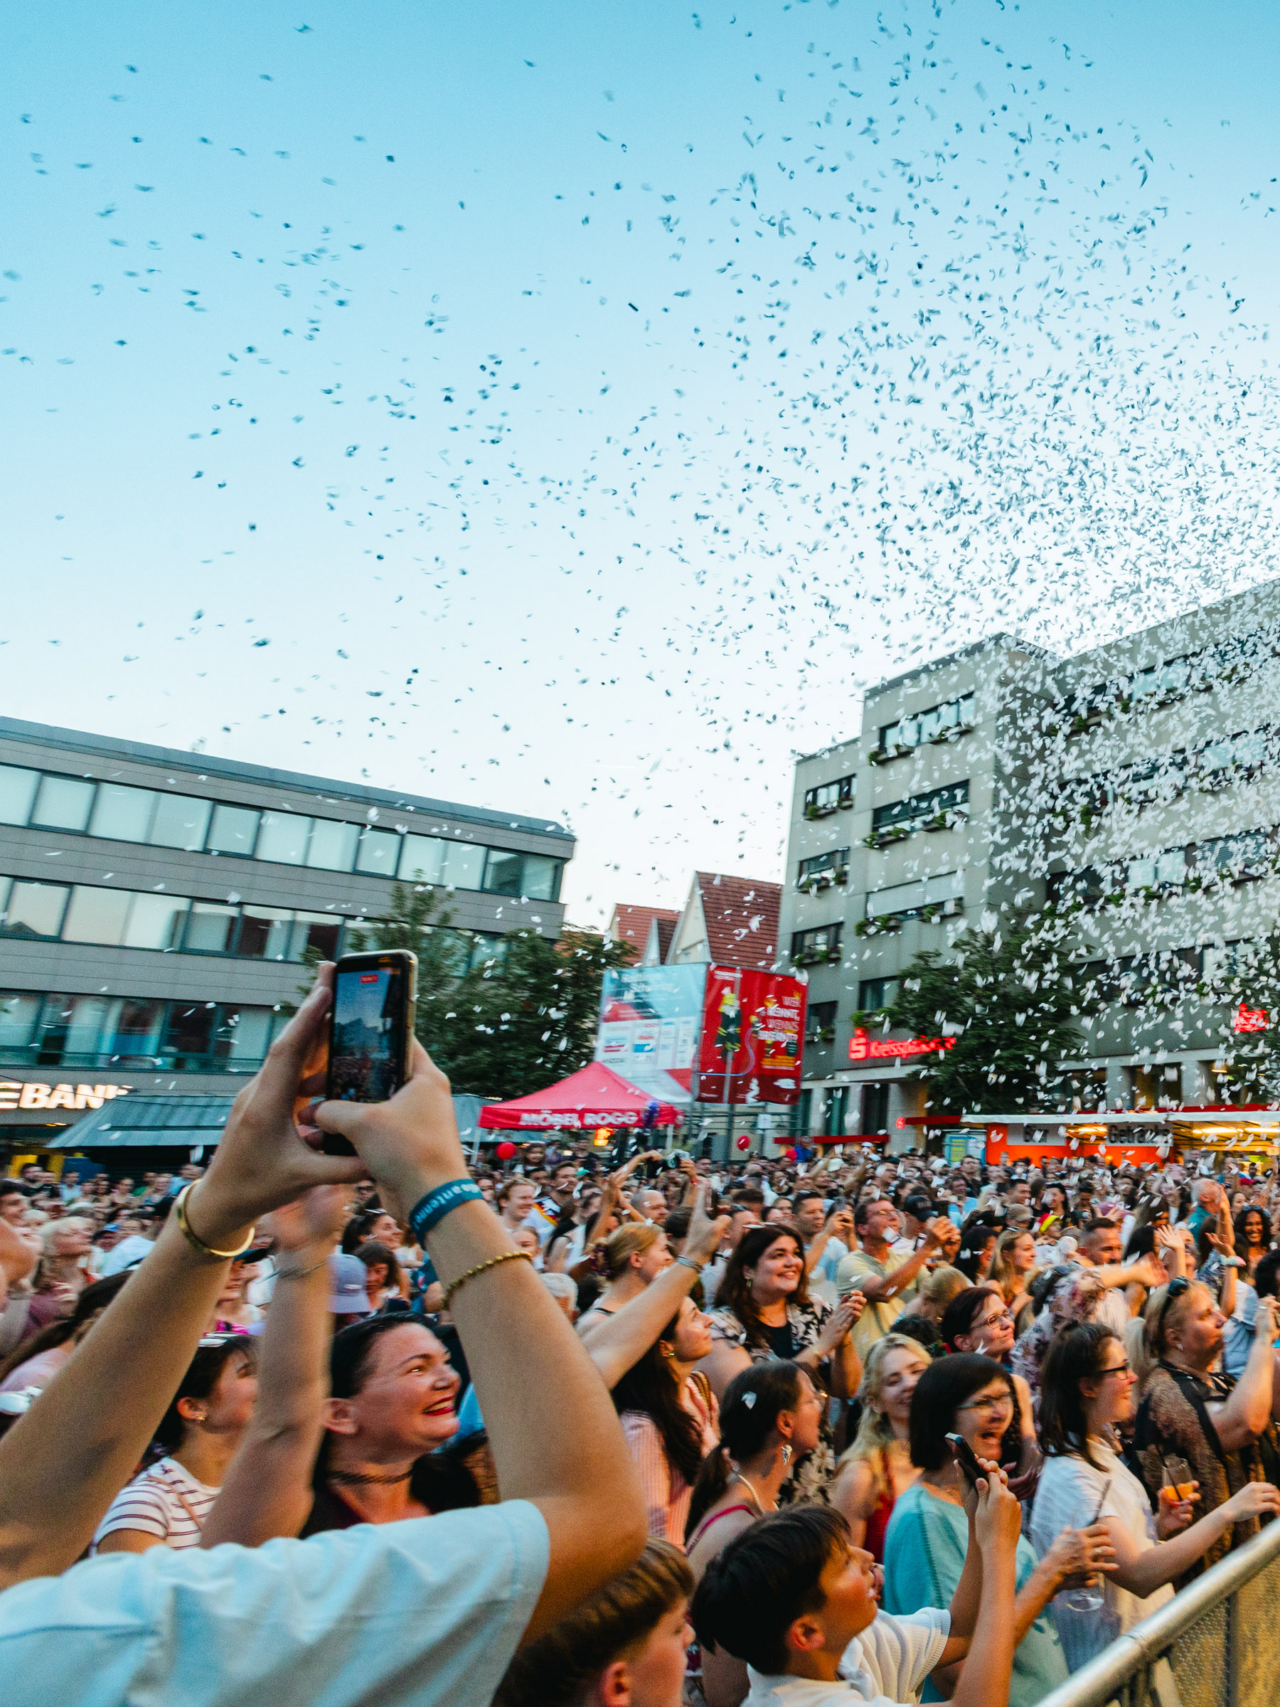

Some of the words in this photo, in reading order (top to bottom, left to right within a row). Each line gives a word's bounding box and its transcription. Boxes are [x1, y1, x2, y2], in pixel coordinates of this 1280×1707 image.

[520, 1110, 580, 1125] MÖBEL
[584, 1112, 638, 1125] ROGG
[1024, 1123, 1049, 1142] Br
[413, 1184, 463, 1224] antenne
